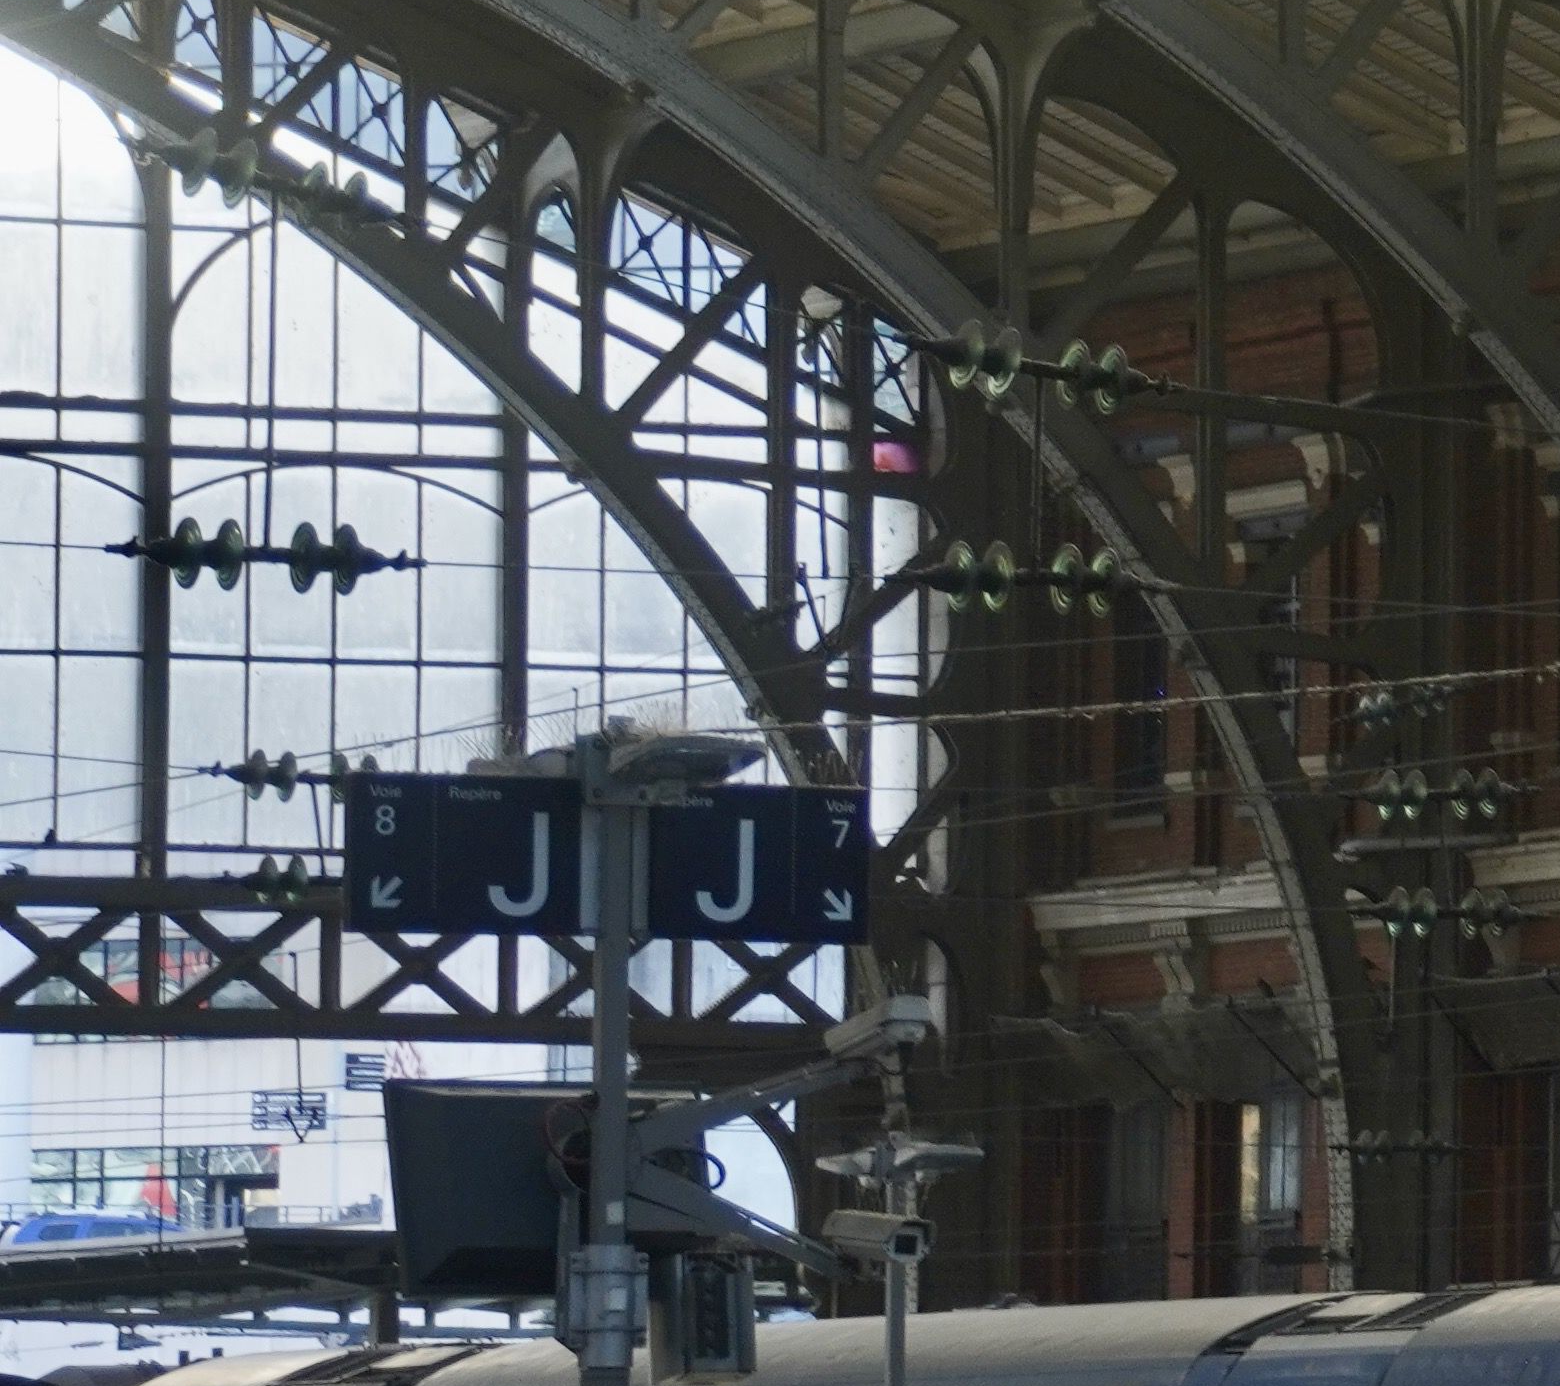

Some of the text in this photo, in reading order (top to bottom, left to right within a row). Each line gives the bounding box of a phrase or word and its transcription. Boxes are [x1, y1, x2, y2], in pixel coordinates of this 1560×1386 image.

[369, 784, 402, 799] Voie
[449, 787, 502, 803] Repère
[375, 805, 396, 836] 8
[825, 799, 857, 814] Voie
[832, 820, 851, 849] 7
[487, 812, 550, 918] J
[696, 818, 755, 923] J
